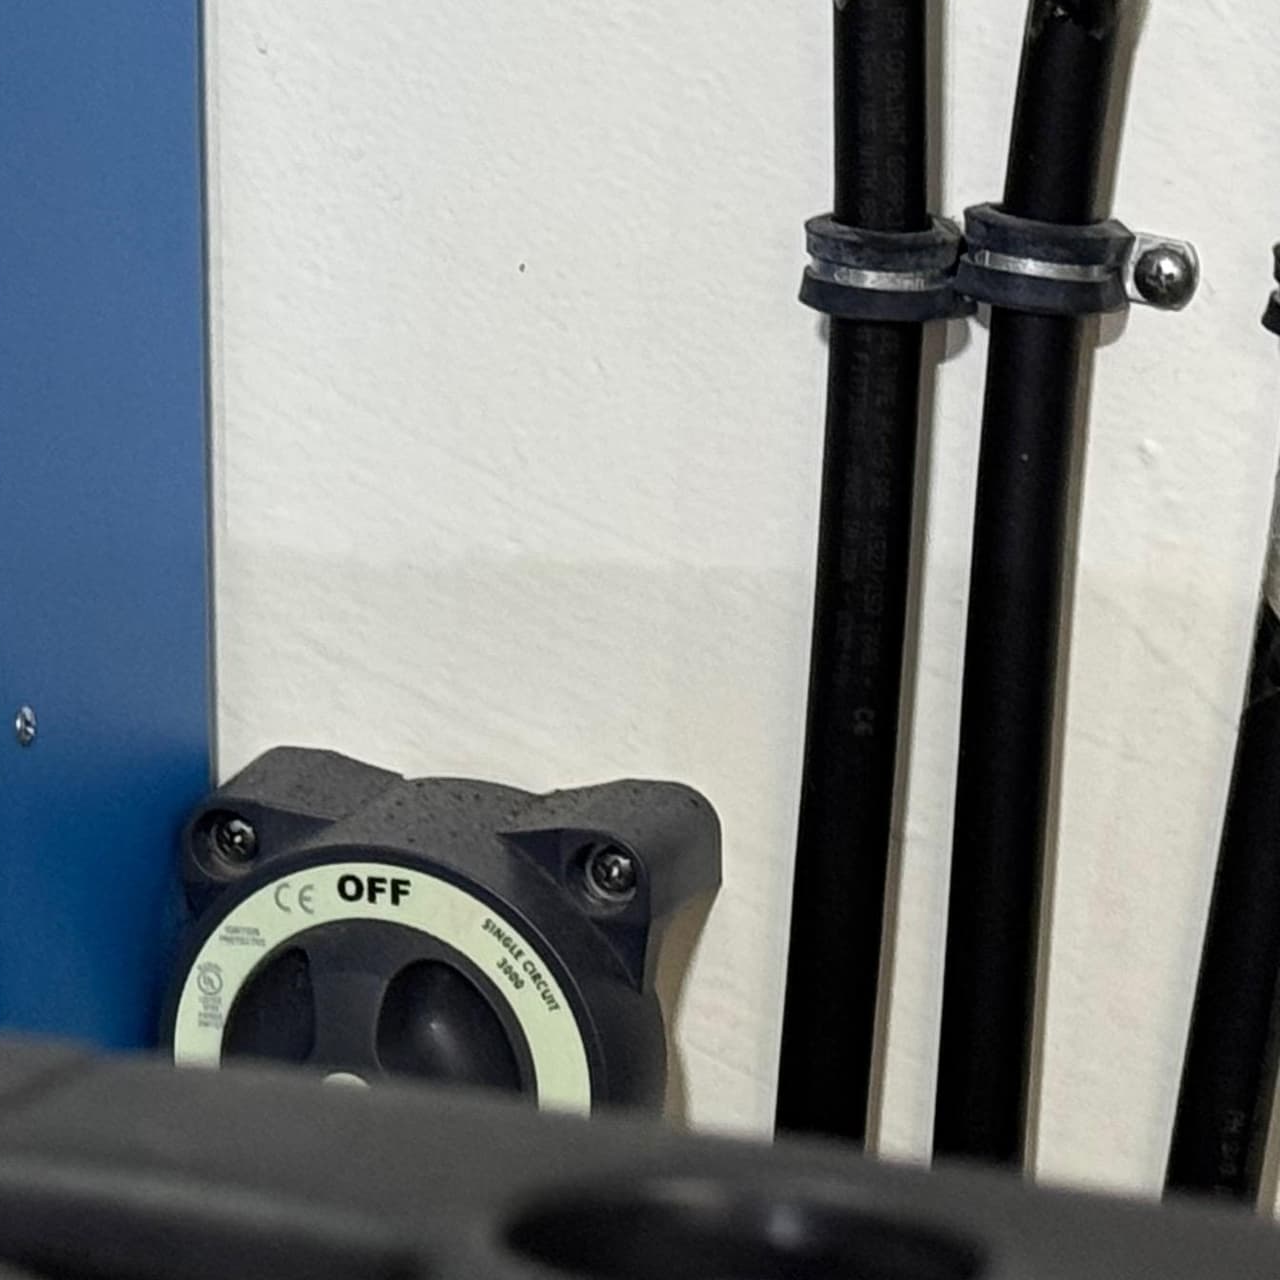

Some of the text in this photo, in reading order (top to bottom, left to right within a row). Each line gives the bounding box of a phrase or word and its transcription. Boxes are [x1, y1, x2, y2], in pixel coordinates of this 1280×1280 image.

[336, 873, 412, 907] OFF
[481, 917, 561, 1012] SINGLE CIRCUIT
